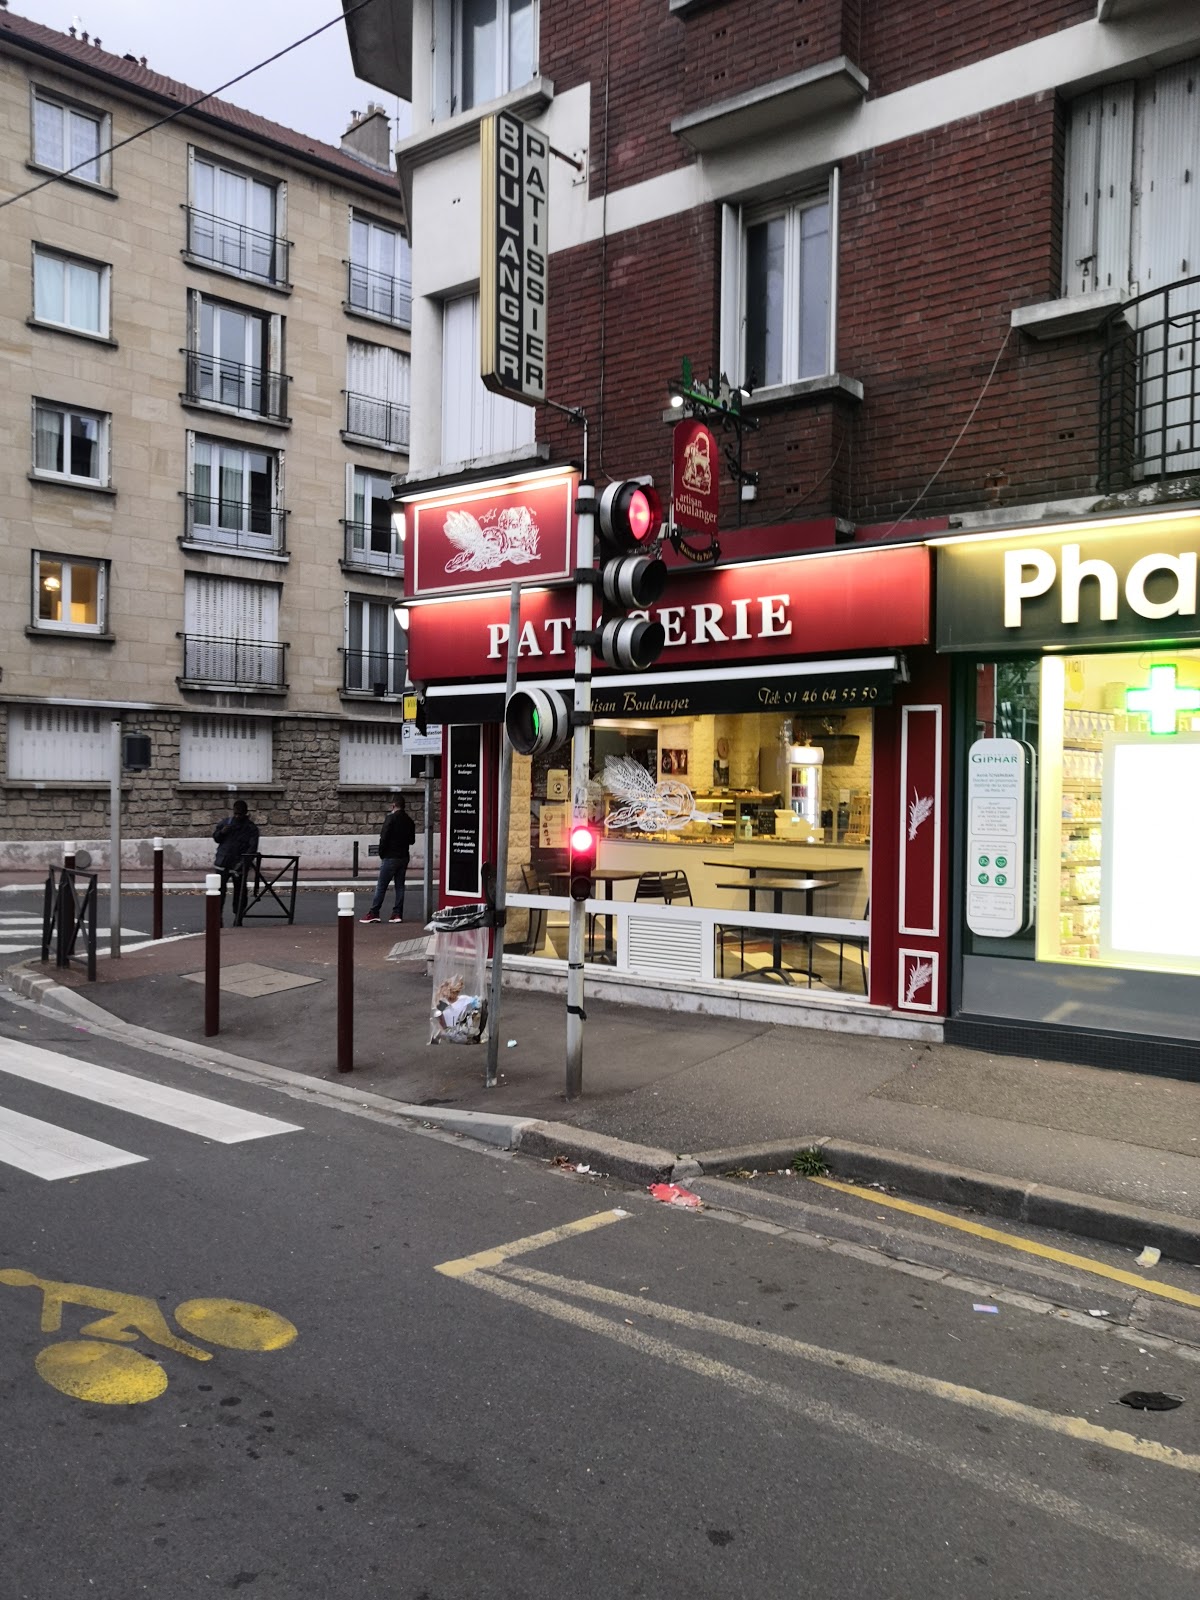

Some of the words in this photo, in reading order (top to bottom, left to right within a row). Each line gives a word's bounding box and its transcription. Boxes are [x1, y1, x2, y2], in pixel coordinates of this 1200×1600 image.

[500, 122, 520, 381] BOULANGER
[526, 134, 545, 391] PATISSIER
[675, 497, 718, 525] boulanger
[680, 493, 702, 508] artisan
[1004, 543, 1198, 628] Pha
[486, 593, 793, 659] PATERIE
[590, 698, 616, 712] tisan
[623, 691, 689, 715] Boulanger
[784, 691, 797, 704] 01
[802, 688, 817, 703] 46
[822, 688, 837, 702] 64
[842, 687, 857, 702] 55
[861, 687, 878, 701] 50
